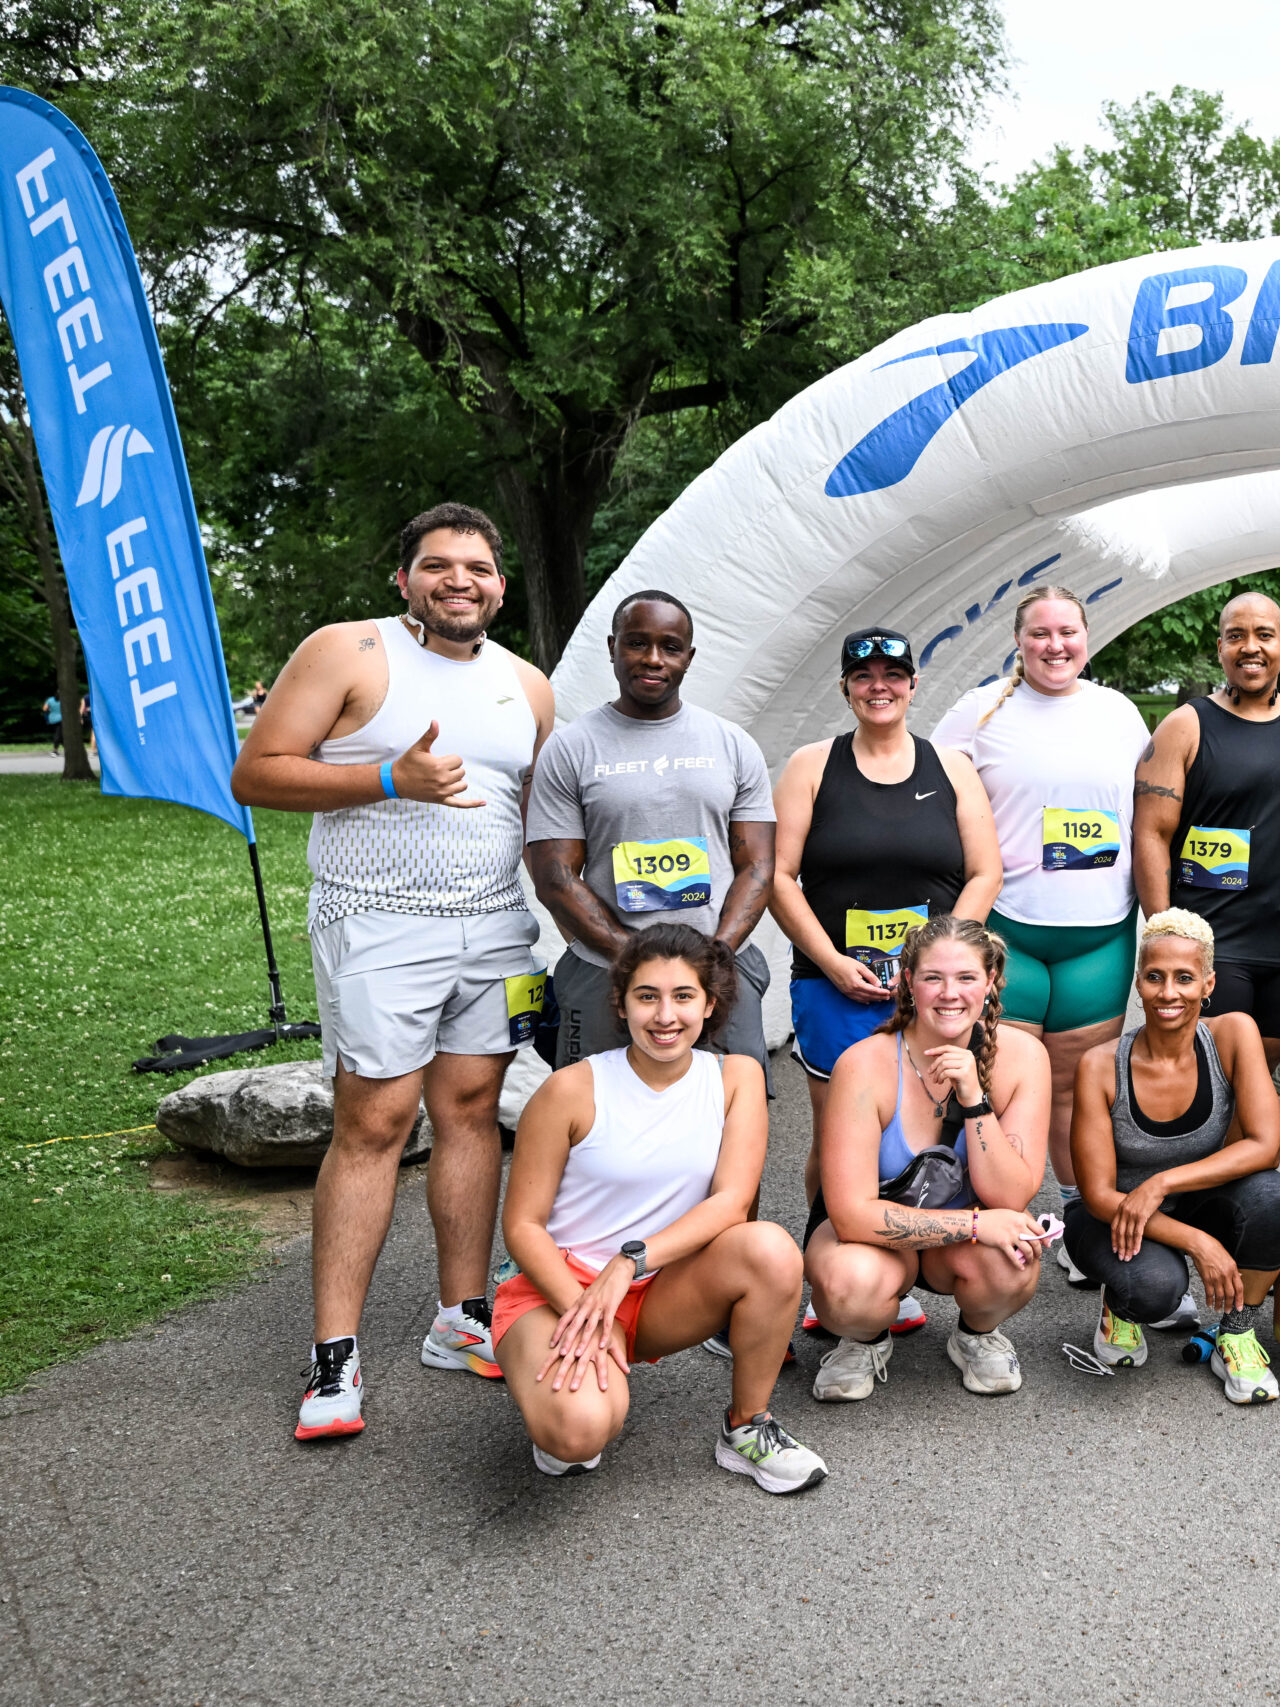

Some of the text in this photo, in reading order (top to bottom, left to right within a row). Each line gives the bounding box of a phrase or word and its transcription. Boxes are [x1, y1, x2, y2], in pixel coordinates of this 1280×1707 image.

[594, 756, 717, 778] FLEET FEET
[1063, 822, 1103, 839] 1192
[1189, 840, 1232, 858] 1379
[633, 853, 691, 875] 1309
[1094, 855, 1113, 864] 2024
[1221, 876, 1242, 886] 2024
[681, 891, 706, 902] 2024
[867, 921, 909, 941] 1137
